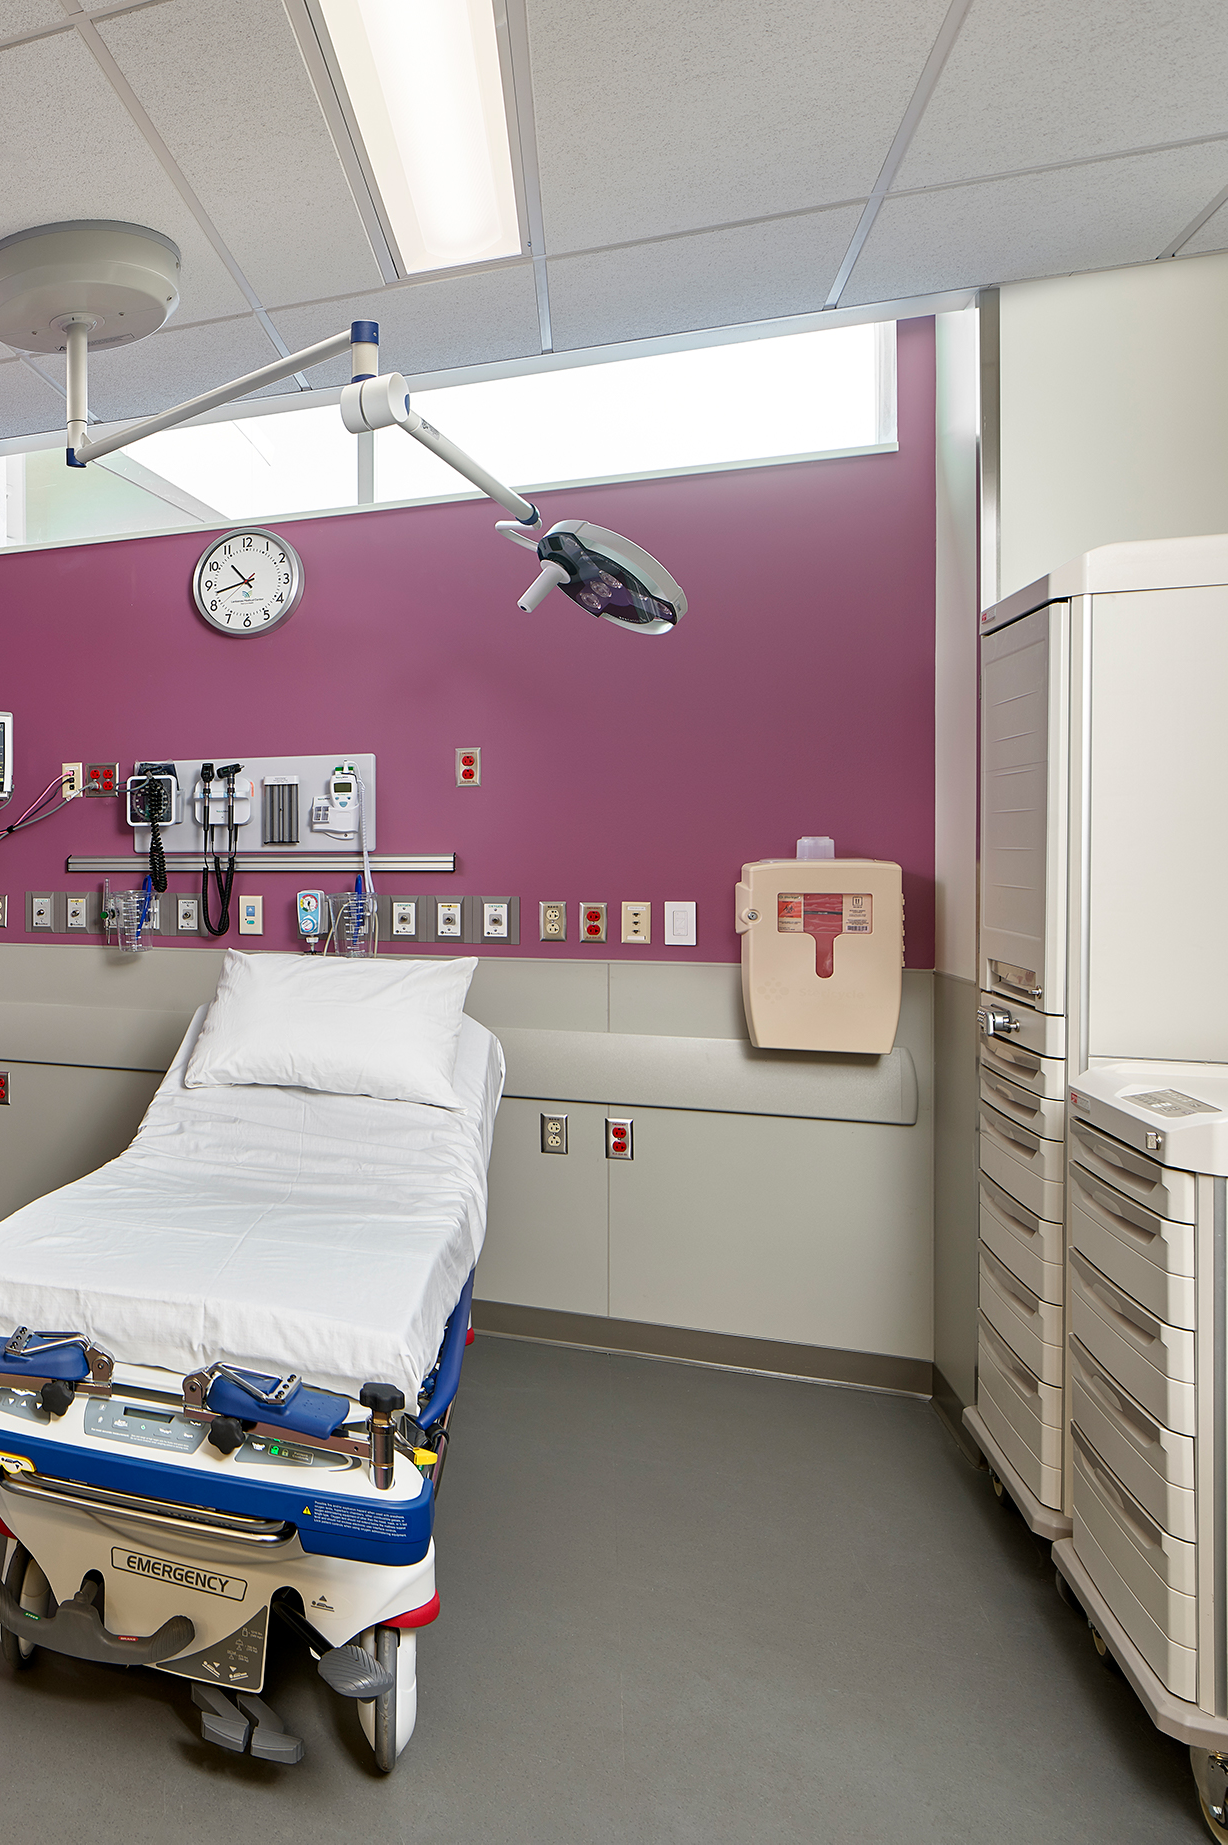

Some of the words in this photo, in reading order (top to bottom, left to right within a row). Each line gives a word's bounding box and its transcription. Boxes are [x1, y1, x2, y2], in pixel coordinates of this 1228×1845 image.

[242, 537, 253, 548] 12
[265, 541, 269, 551] 1
[223, 545, 231, 555] 11
[278, 552, 286, 563] 2
[209, 561, 219, 572] 10
[283, 573, 290, 584] 3
[205, 580, 213, 591] 9
[276, 592, 284, 603] 4
[210, 600, 218, 611] 8
[225, 614, 232, 624] 7
[263, 610, 270, 621] 5
[243, 616, 252, 628] 6
[126, 1555, 229, 1593] EMERGENCY
